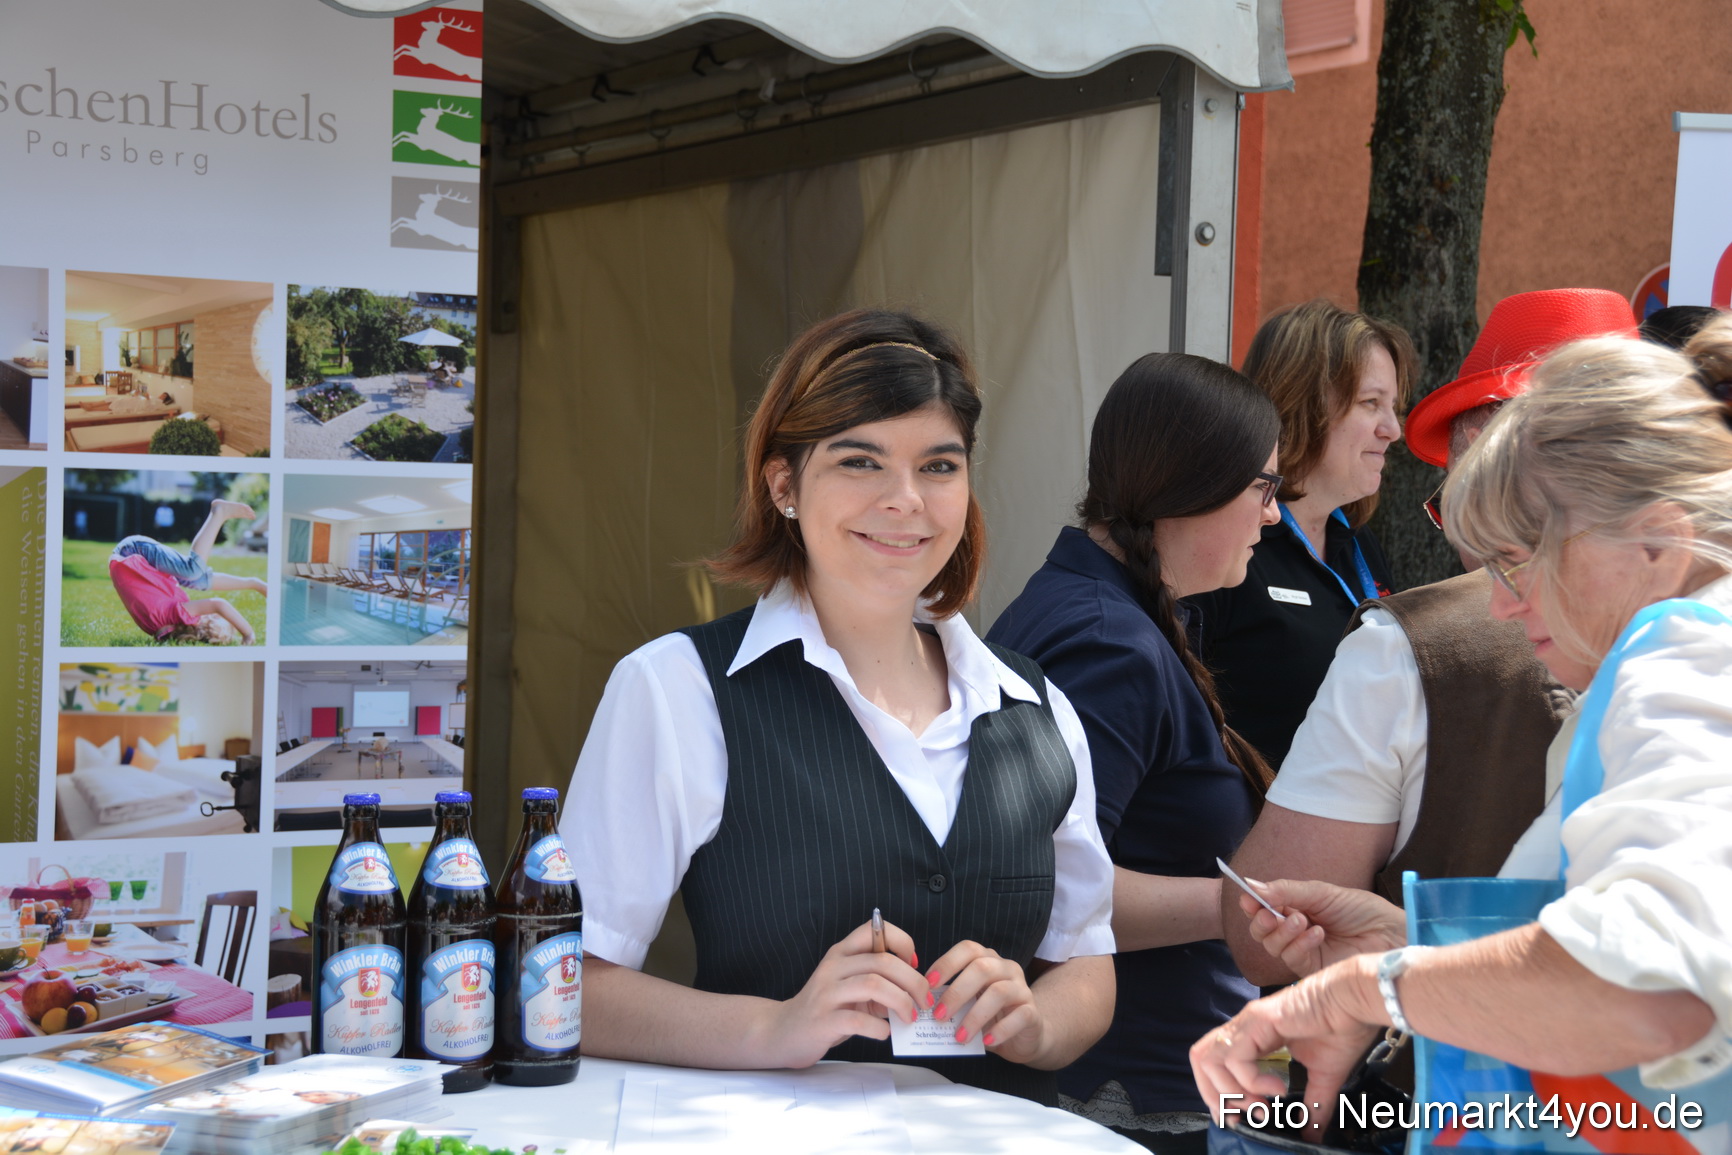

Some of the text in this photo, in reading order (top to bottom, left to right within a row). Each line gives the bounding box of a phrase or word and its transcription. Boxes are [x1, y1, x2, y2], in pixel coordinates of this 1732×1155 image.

[27, 129, 209, 176] Parsberg
[33, 534, 46, 647] Dummen
[13, 486, 32, 842] die Weisen gehen in den Garten
[29, 656, 41, 741] rennen,
[28, 750, 39, 787] die
[341, 846, 376, 865] Winkler
[435, 842, 468, 860] Winkler
[432, 948, 480, 974] Winkler
[533, 941, 576, 967] Winkler
[330, 952, 402, 978] Winkler Bräu
[350, 996, 388, 1009] Lengenfeld
[453, 990, 487, 1004] Lengenfeld
[429, 1018, 469, 1038] Kupfer
[531, 1011, 567, 1031] Kupfer
[327, 1024, 367, 1044] Kupfer
[443, 1034, 489, 1049] ALKOHOLFREI
[340, 1040, 391, 1055] ALKOHOLFREI
